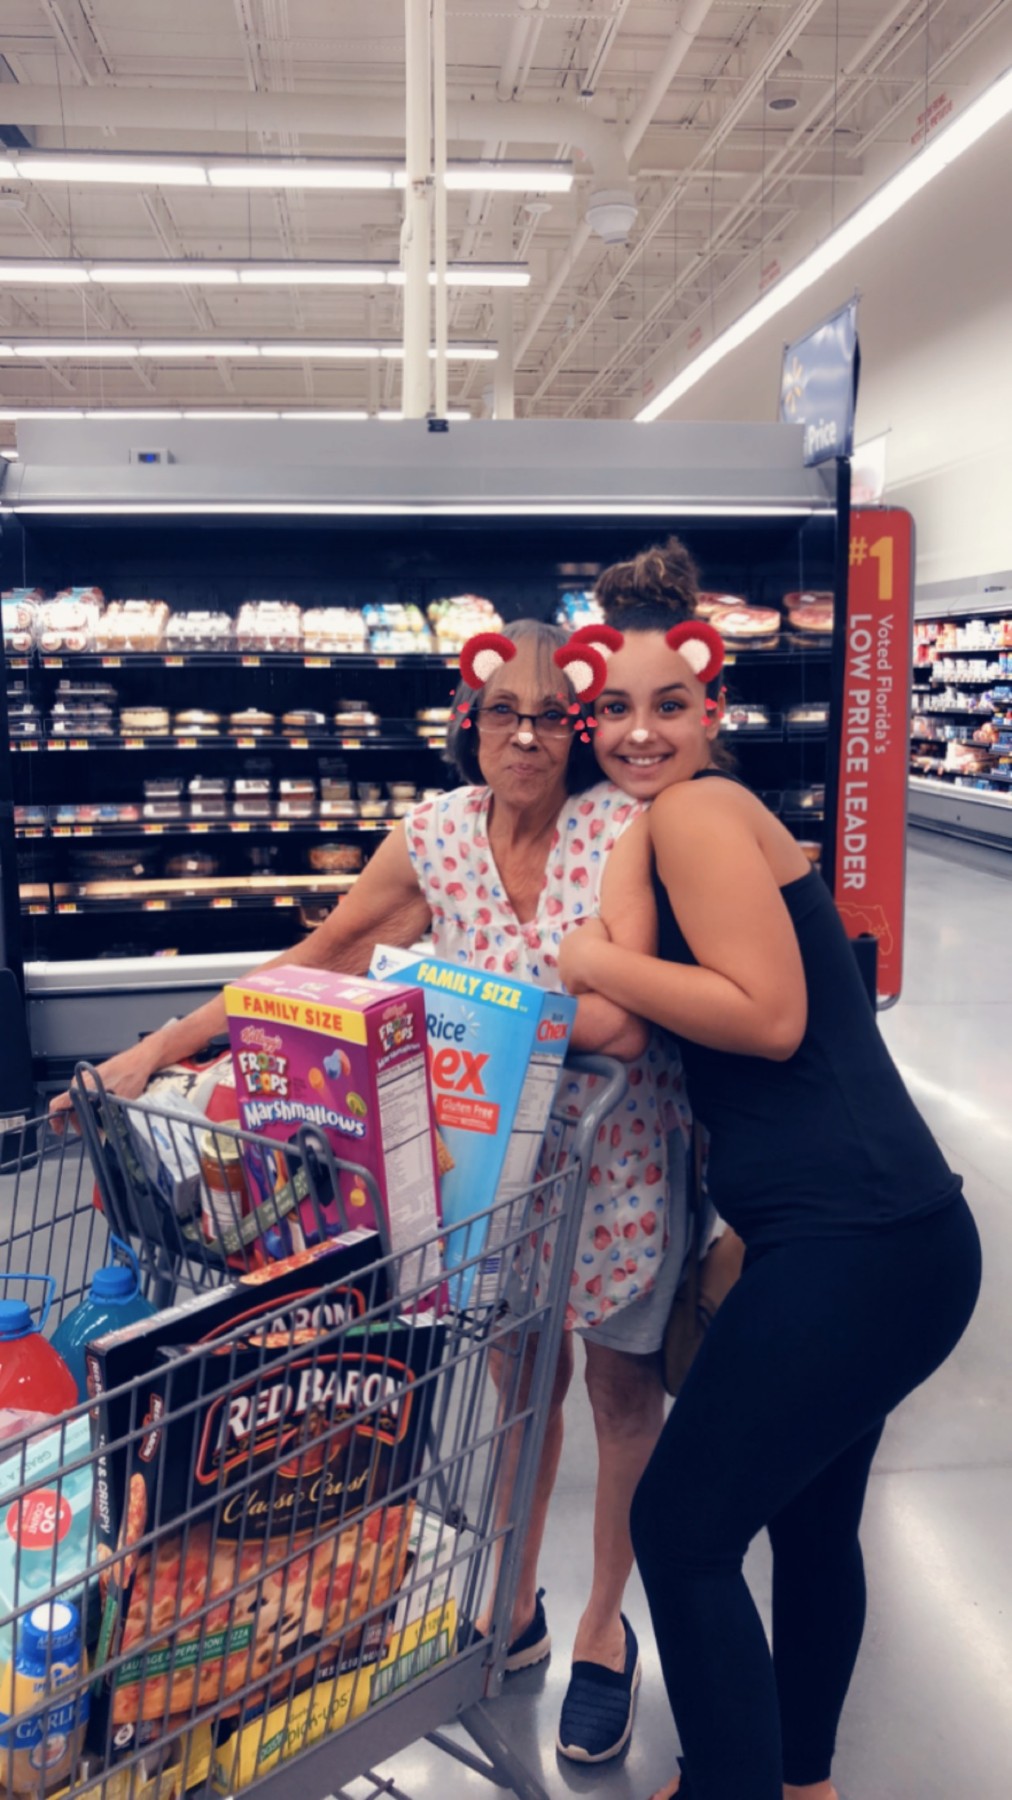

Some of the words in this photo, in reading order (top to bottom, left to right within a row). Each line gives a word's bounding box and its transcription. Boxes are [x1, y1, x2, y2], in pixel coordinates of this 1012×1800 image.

[848, 536, 893, 600] #1
[849, 614, 873, 680] LOW
[876, 614, 894, 670] Voted
[846, 688, 871, 773] PRICE
[874, 676, 893, 754] Florida's
[843, 781, 868, 890] LEADER
[416, 963, 483, 996] FAMILY
[480, 981, 522, 1010] SIZE
[243, 995, 300, 1022] FAMILY
[304, 1008, 343, 1032] SIZE
[426, 1012, 465, 1042] Rice
[238, 1052, 287, 1074] FROOT
[244, 1072, 288, 1096] LOOPS
[243, 1100, 366, 1137] Marshmallows
[255, 1303, 354, 1335] ARON
[217, 1383, 294, 1449] RED
[293, 1368, 403, 1416] BARON
[98, 1479, 110, 1534] CRISPY
[16, 1704, 76, 1739] GARLI
